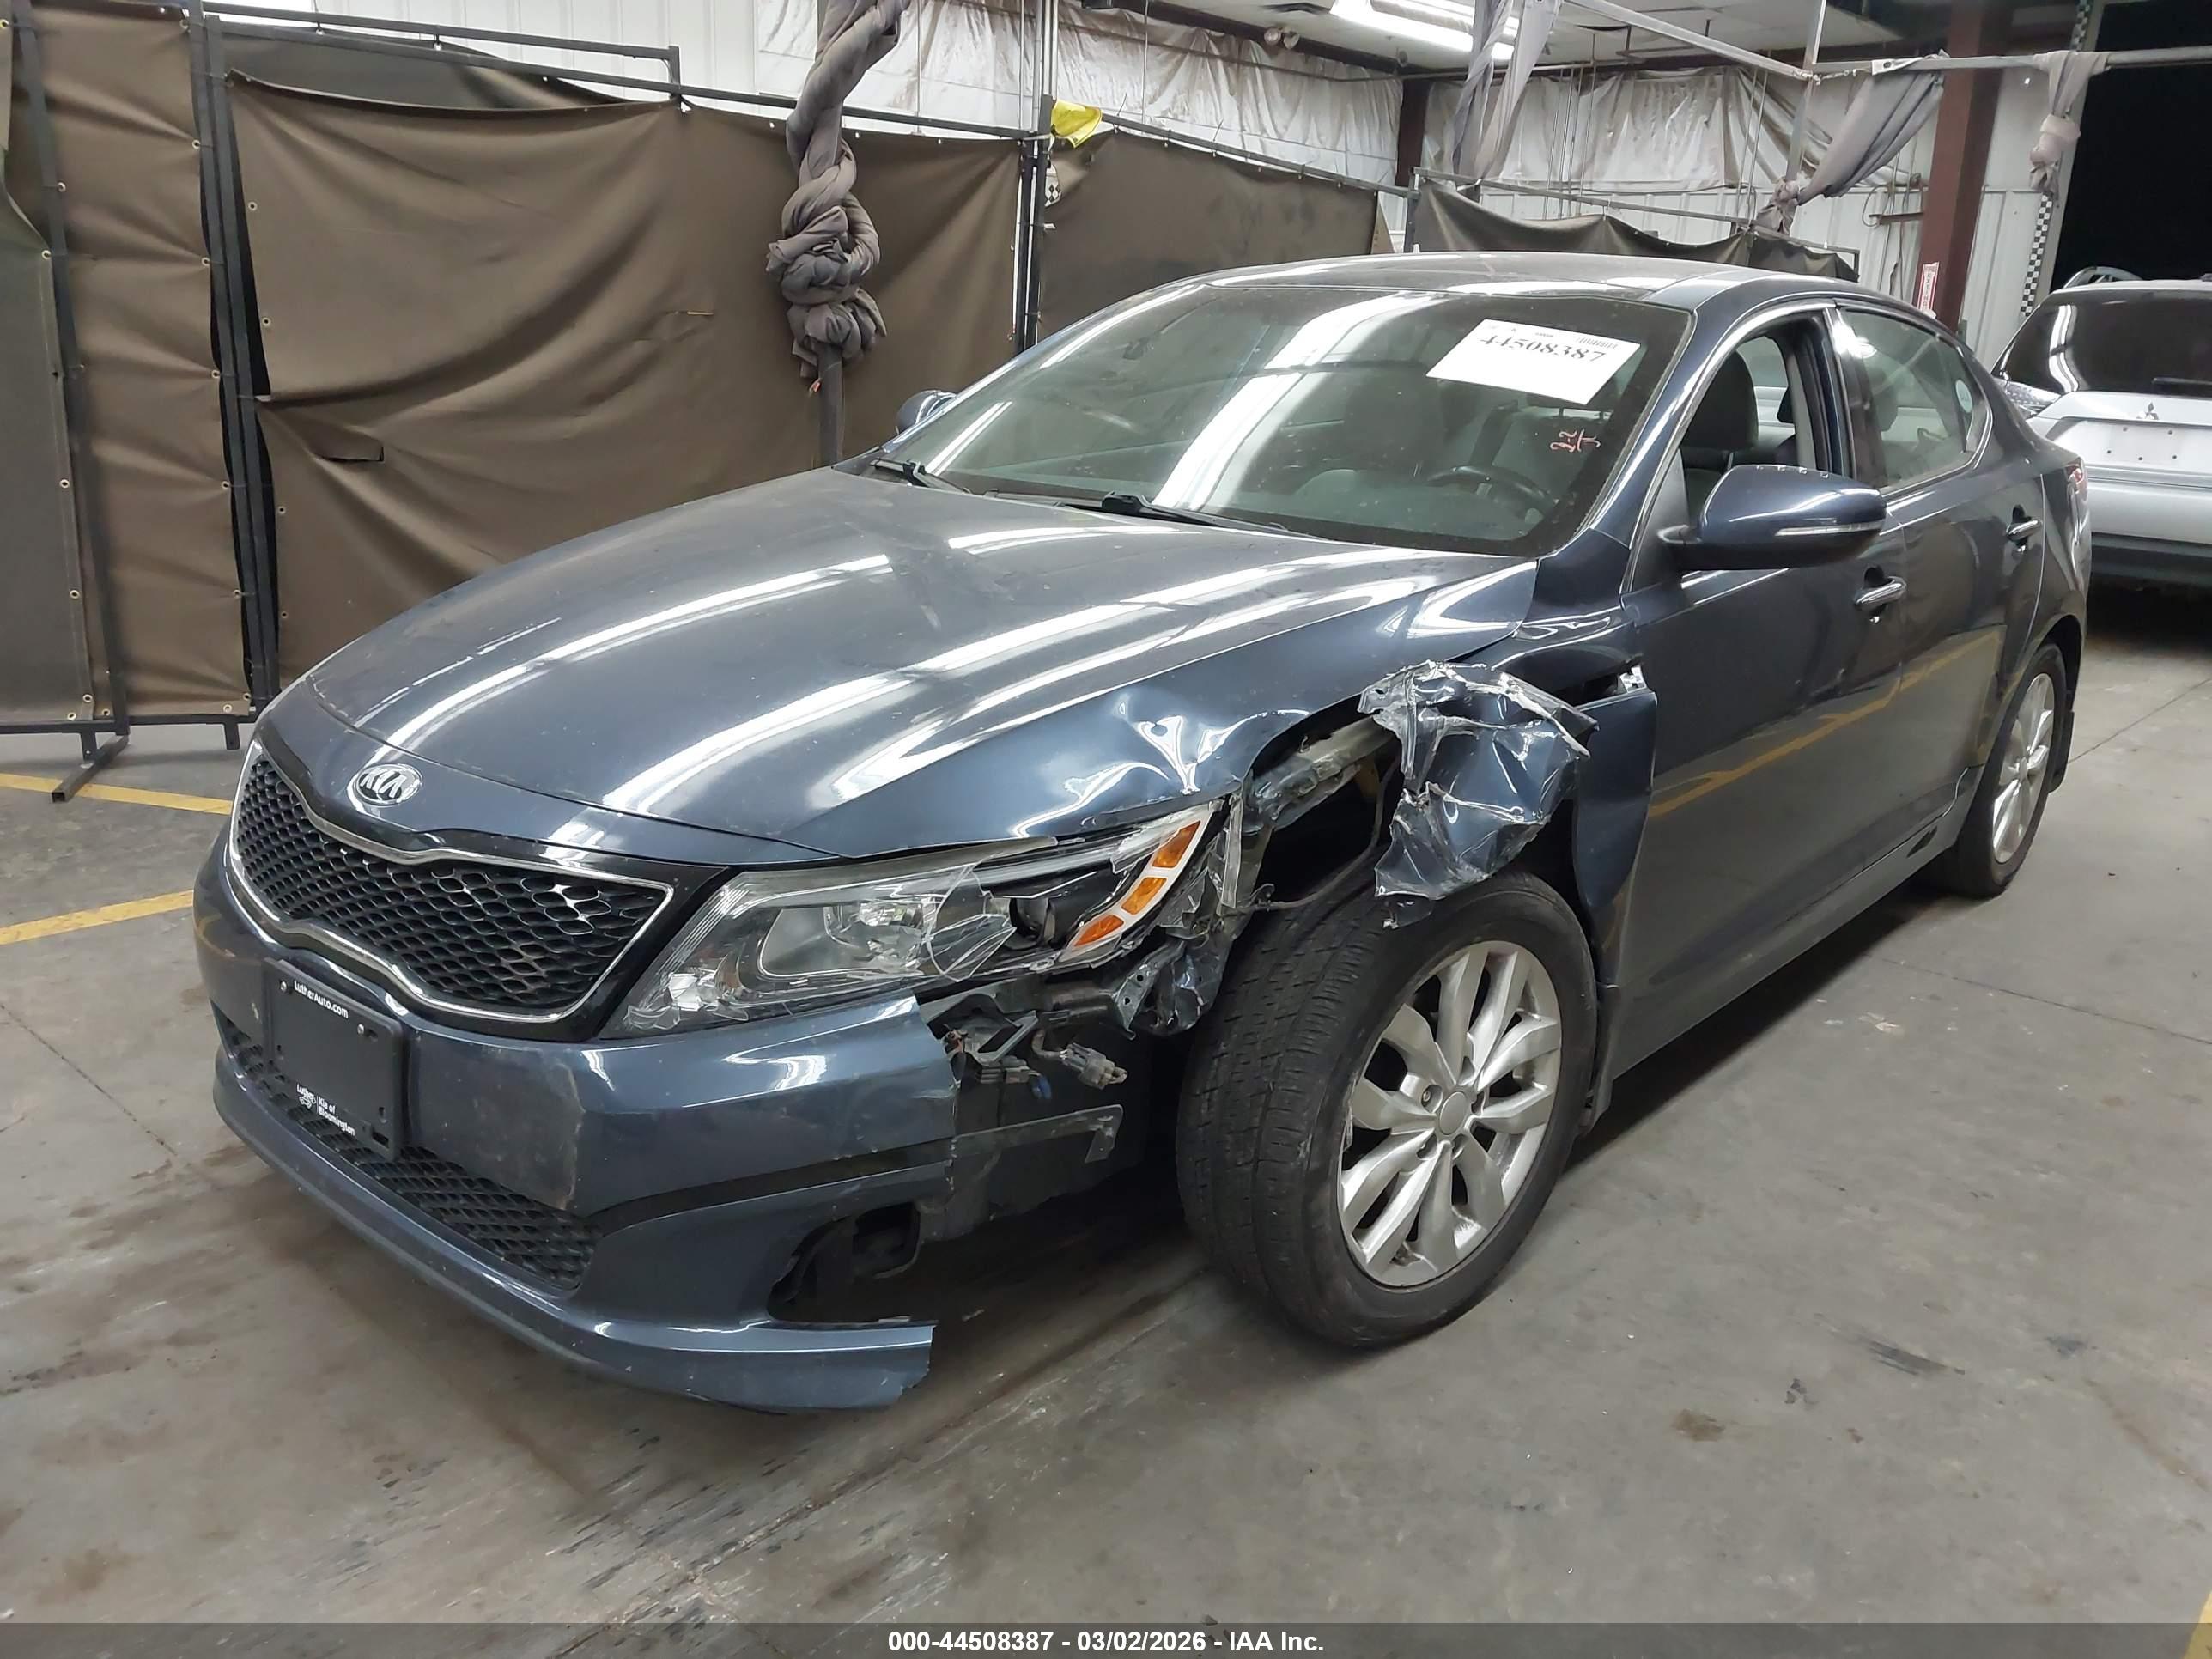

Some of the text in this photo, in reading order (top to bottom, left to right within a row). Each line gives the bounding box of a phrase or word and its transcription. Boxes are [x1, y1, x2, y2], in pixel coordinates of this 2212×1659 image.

[1479, 335, 1607, 362] 44508387
[294, 980, 349, 1018] LutherAuto.com
[296, 1083, 315, 1100] Luther
[319, 1096, 336, 1115] Kia of
[319, 1105, 356, 1137] Bloomington
